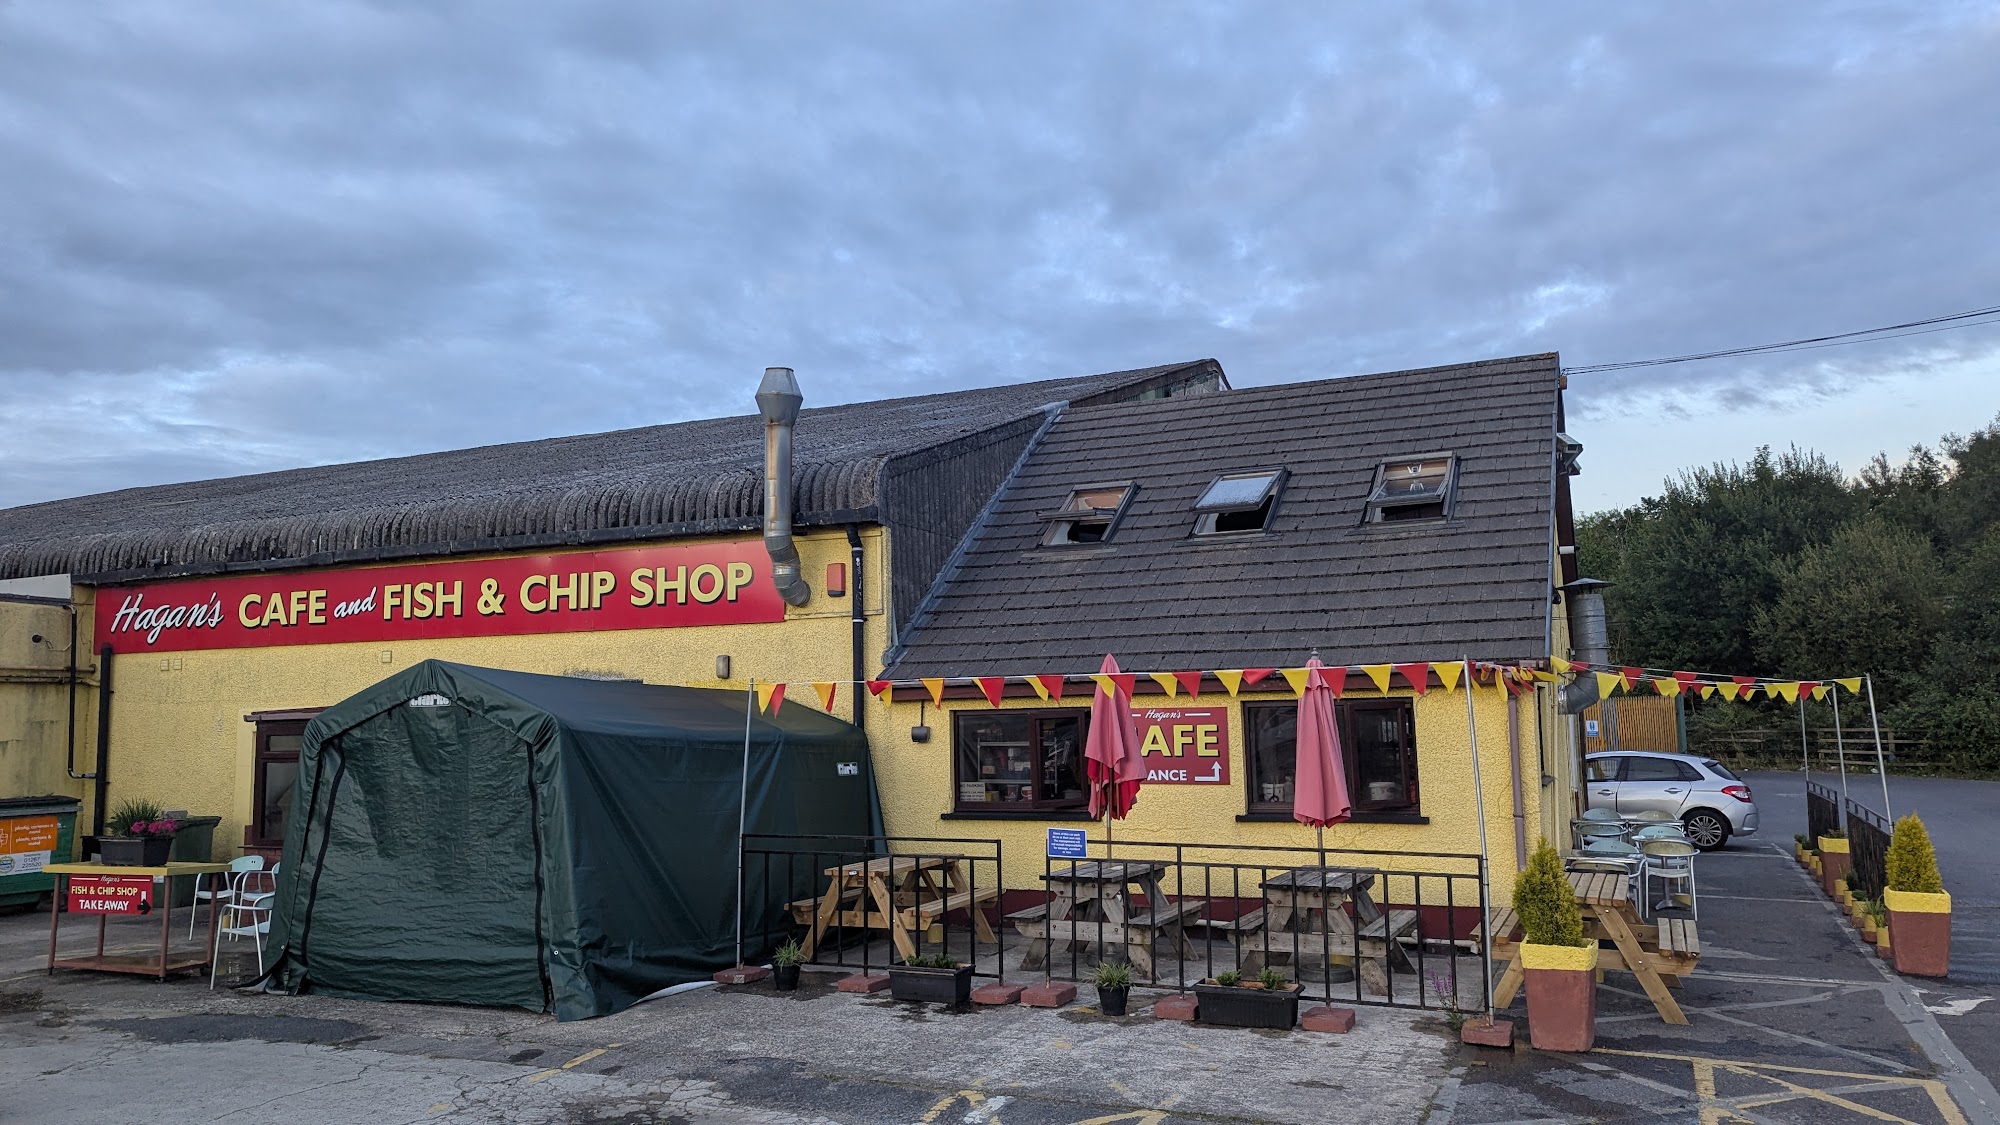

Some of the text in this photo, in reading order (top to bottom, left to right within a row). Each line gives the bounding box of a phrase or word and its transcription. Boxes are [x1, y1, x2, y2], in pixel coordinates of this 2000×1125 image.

[110, 562, 753, 644] Hagan's CAFE and FISH & CHIP SHOP
[1144, 709, 1182, 722] Hagan's
[1140, 724, 1219, 757] AFE
[1147, 769, 1187, 781] ANCE
[71, 885, 138, 896] FISH & CHIP SHOP
[79, 899, 129, 911] TAKEAWAY
